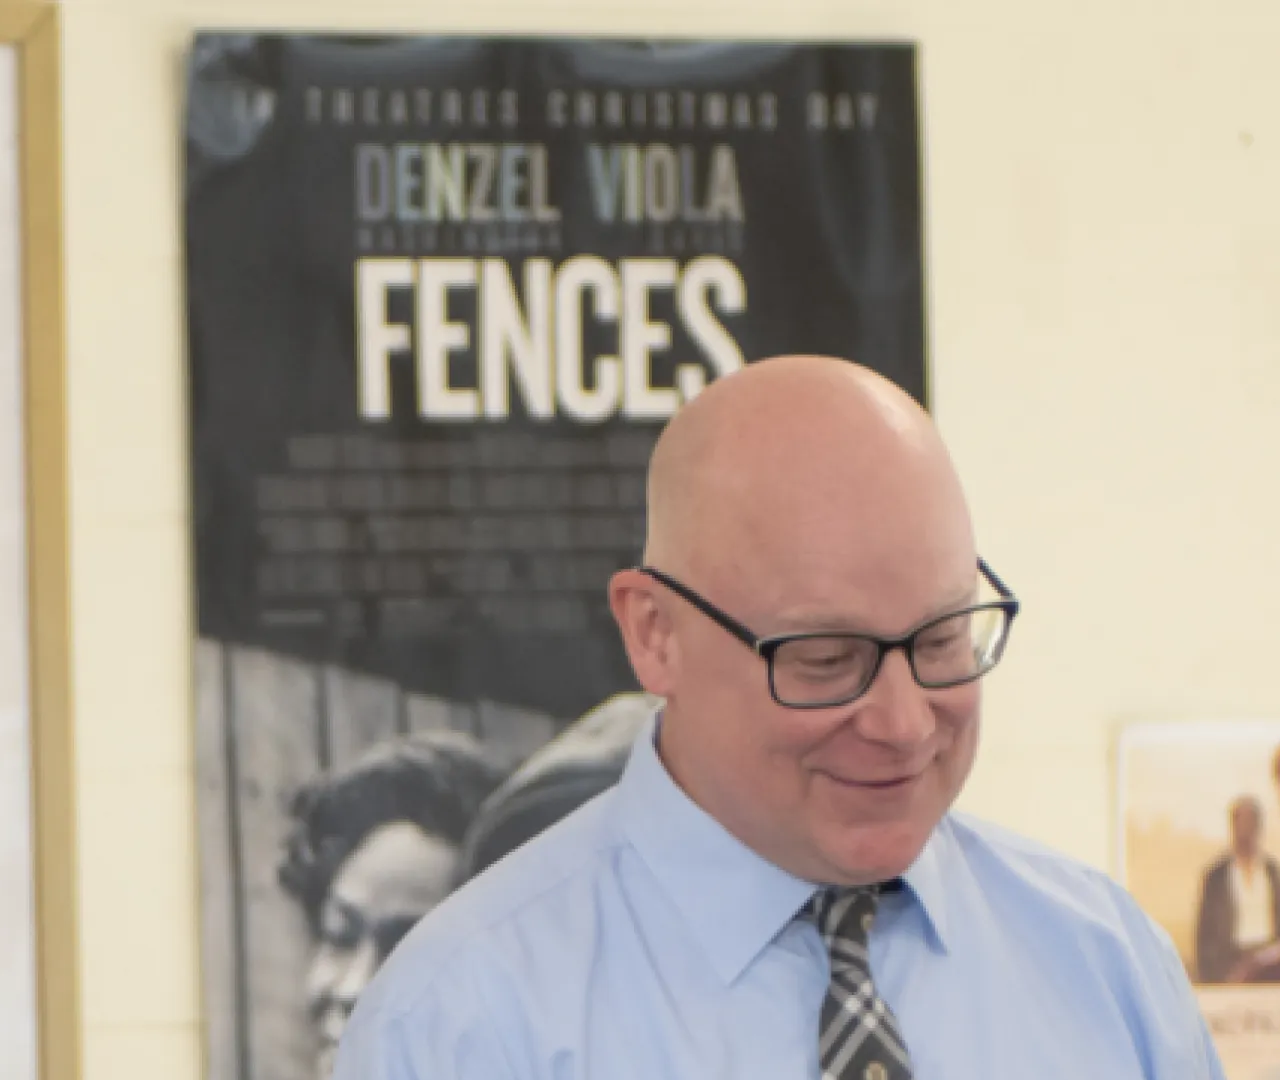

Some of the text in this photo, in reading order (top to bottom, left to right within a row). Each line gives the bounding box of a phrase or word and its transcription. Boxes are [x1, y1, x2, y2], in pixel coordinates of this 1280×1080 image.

[545, 88, 778, 130] CHRISTMAS
[355, 143, 745, 223] DENZEL VIOLA
[355, 255, 747, 420] FENCES
